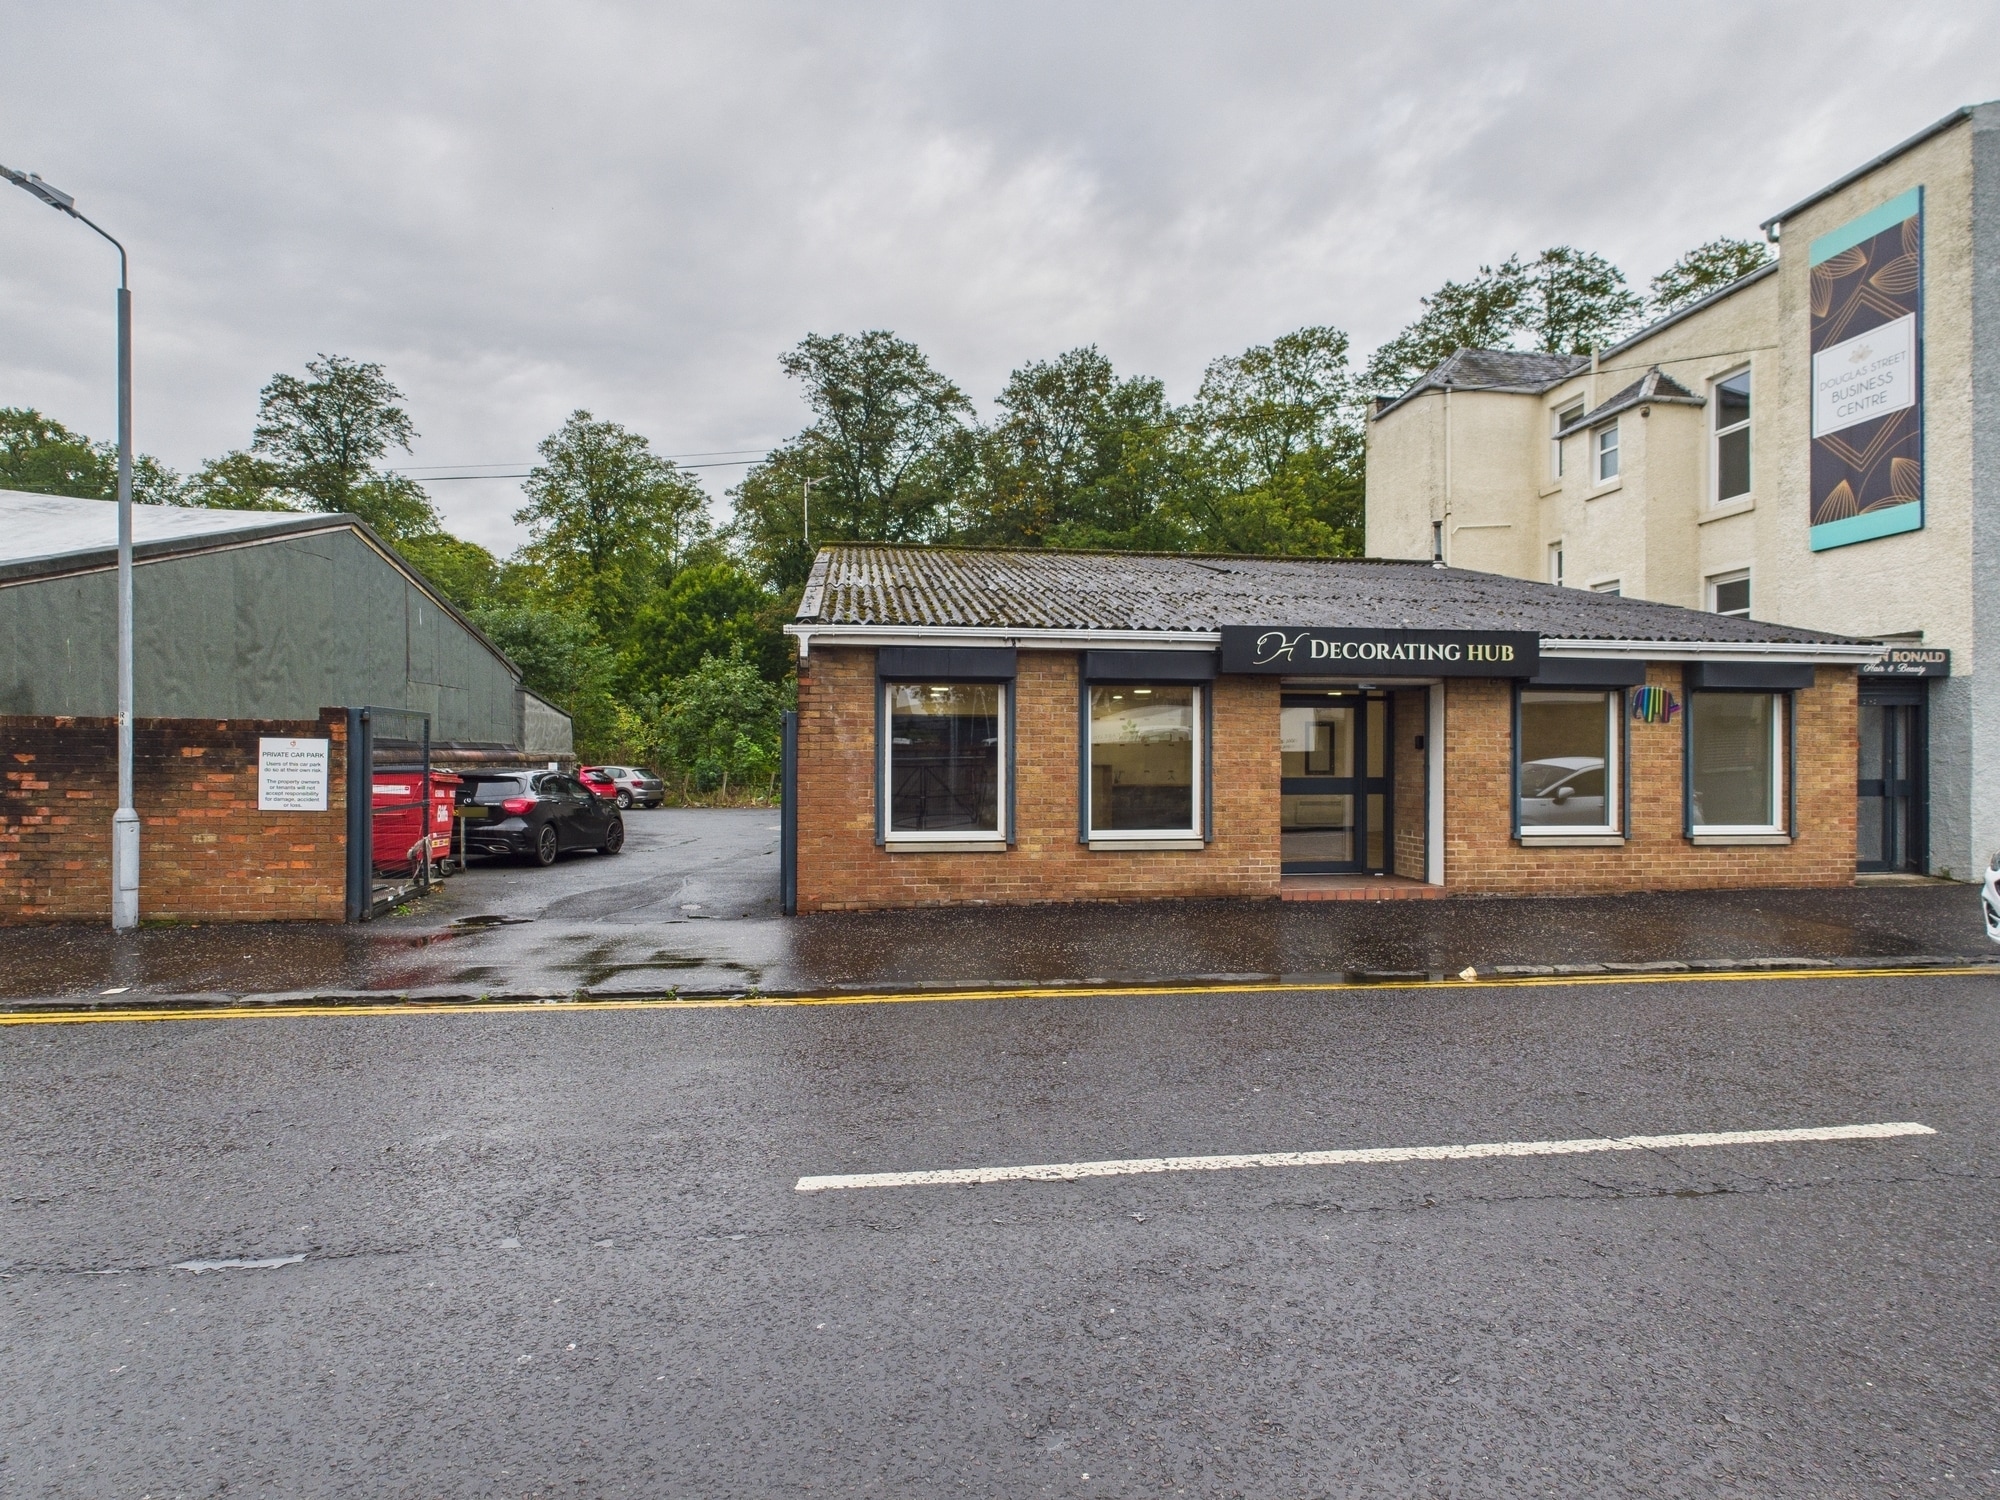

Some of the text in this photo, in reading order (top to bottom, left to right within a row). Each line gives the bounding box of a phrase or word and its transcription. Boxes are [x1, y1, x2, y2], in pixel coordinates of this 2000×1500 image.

[1820, 350, 1906, 391] DOUGLAS STREET
[1832, 371, 1893, 404] BUSINESS
[1837, 390, 1887, 417] CENTRE
[1310, 639, 1461, 661] DECORATING
[1467, 644, 1514, 661] HUB
[1892, 651, 1945, 662] RONALD
[1863, 663, 1885, 672] Hair
[1896, 663, 1926, 675] Beauty
